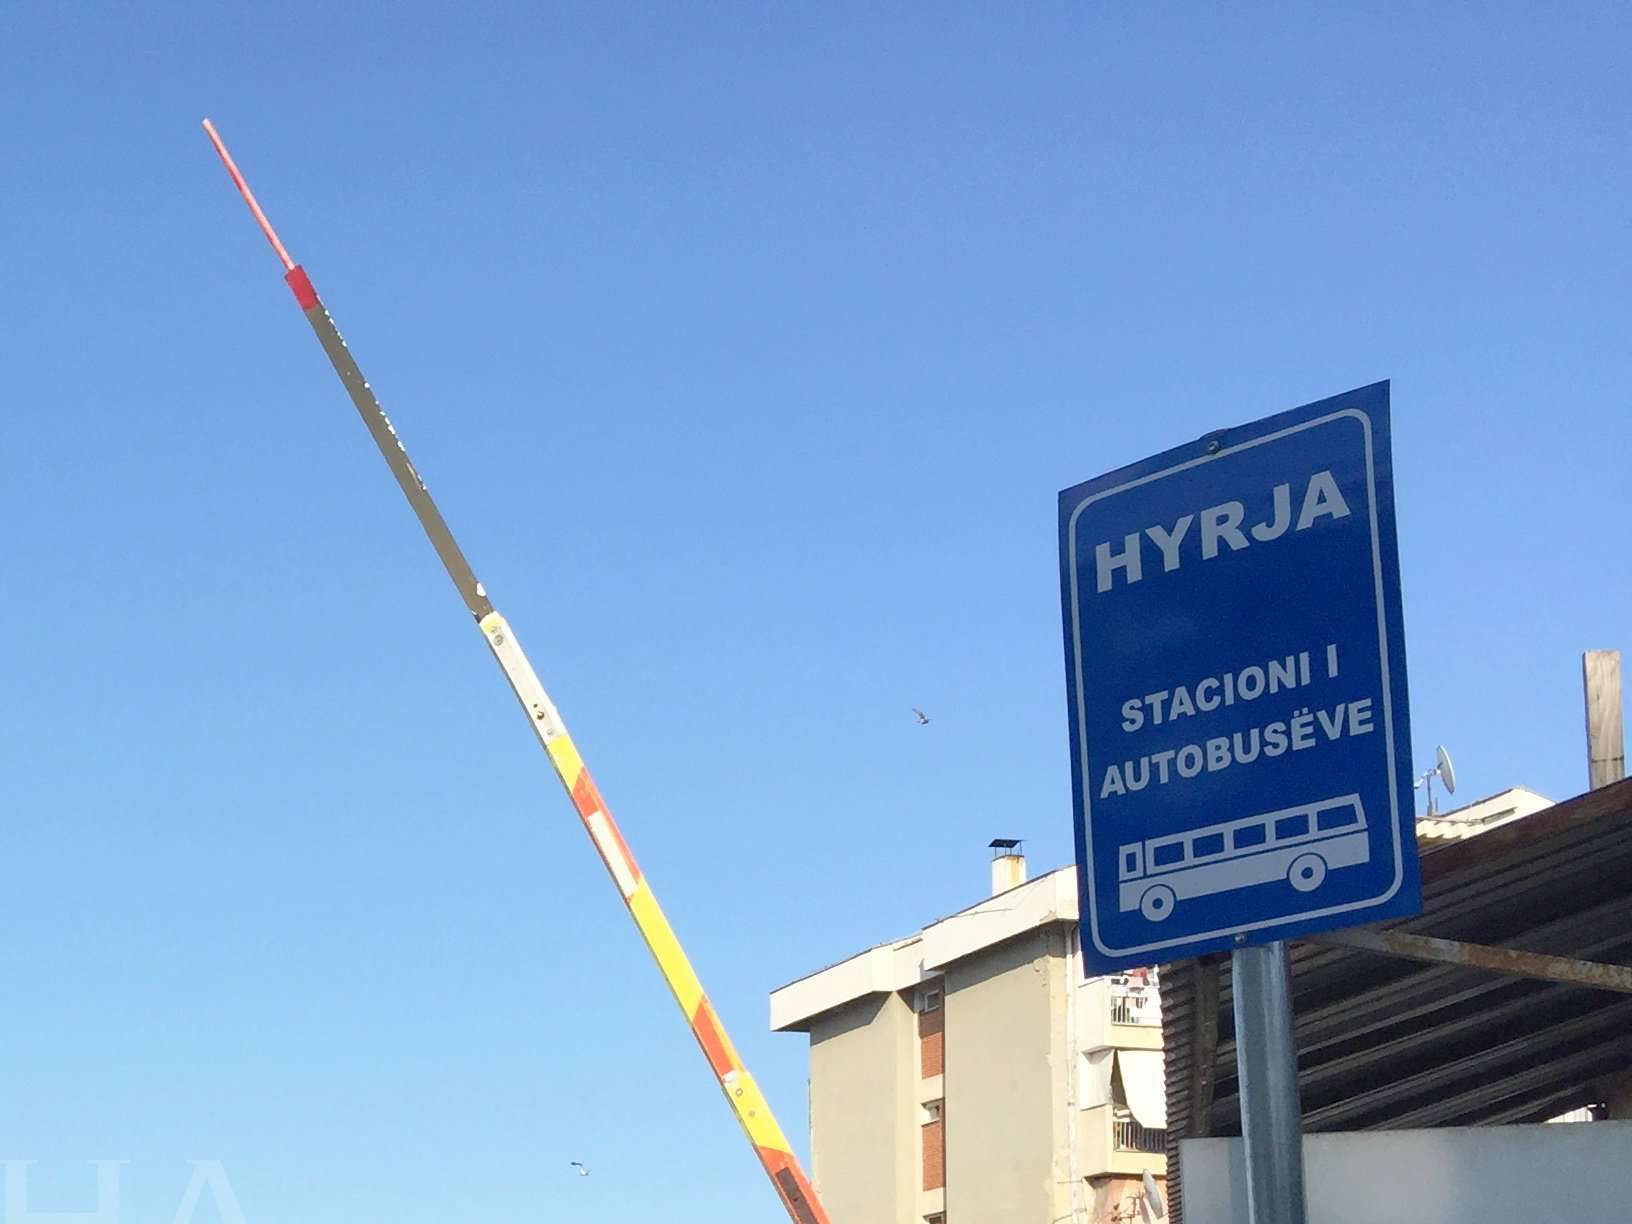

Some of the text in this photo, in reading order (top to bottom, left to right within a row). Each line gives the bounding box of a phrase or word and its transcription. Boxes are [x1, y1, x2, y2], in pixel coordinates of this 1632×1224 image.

[1095, 470, 1351, 593] HYRJA
[1120, 643, 1339, 732] STACIONI I
[1100, 698, 1374, 799] AUTOBUSËVE
